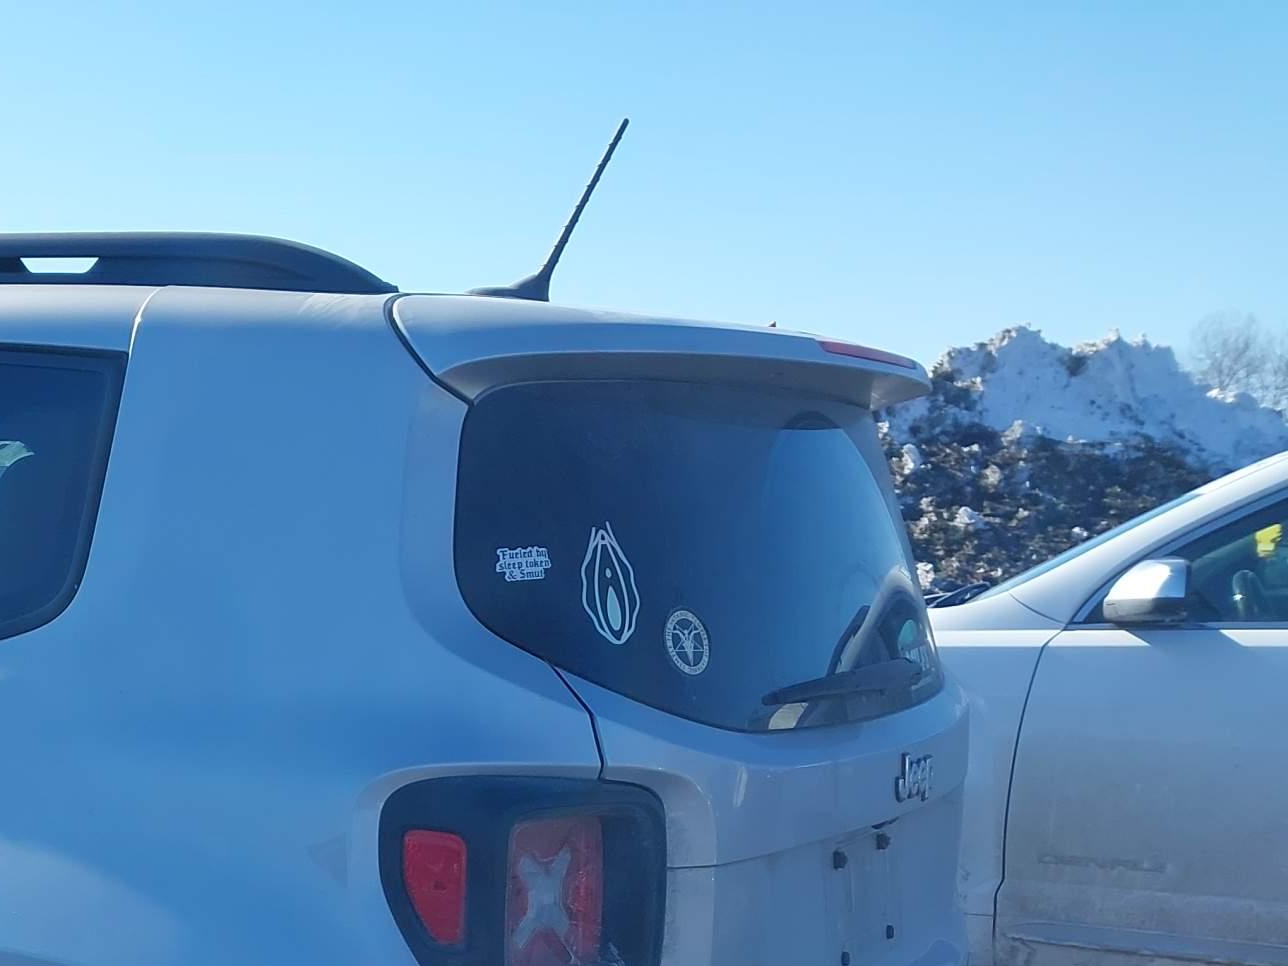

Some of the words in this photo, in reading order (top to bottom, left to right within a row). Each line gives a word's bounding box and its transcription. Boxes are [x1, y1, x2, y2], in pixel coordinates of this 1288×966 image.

[499, 549, 533, 560] Fueled
[535, 549, 547, 559] by
[526, 559, 550, 568] token
[507, 569, 518, 580] &
[519, 568, 543, 579] Smut
[895, 752, 934, 802] Jeep
